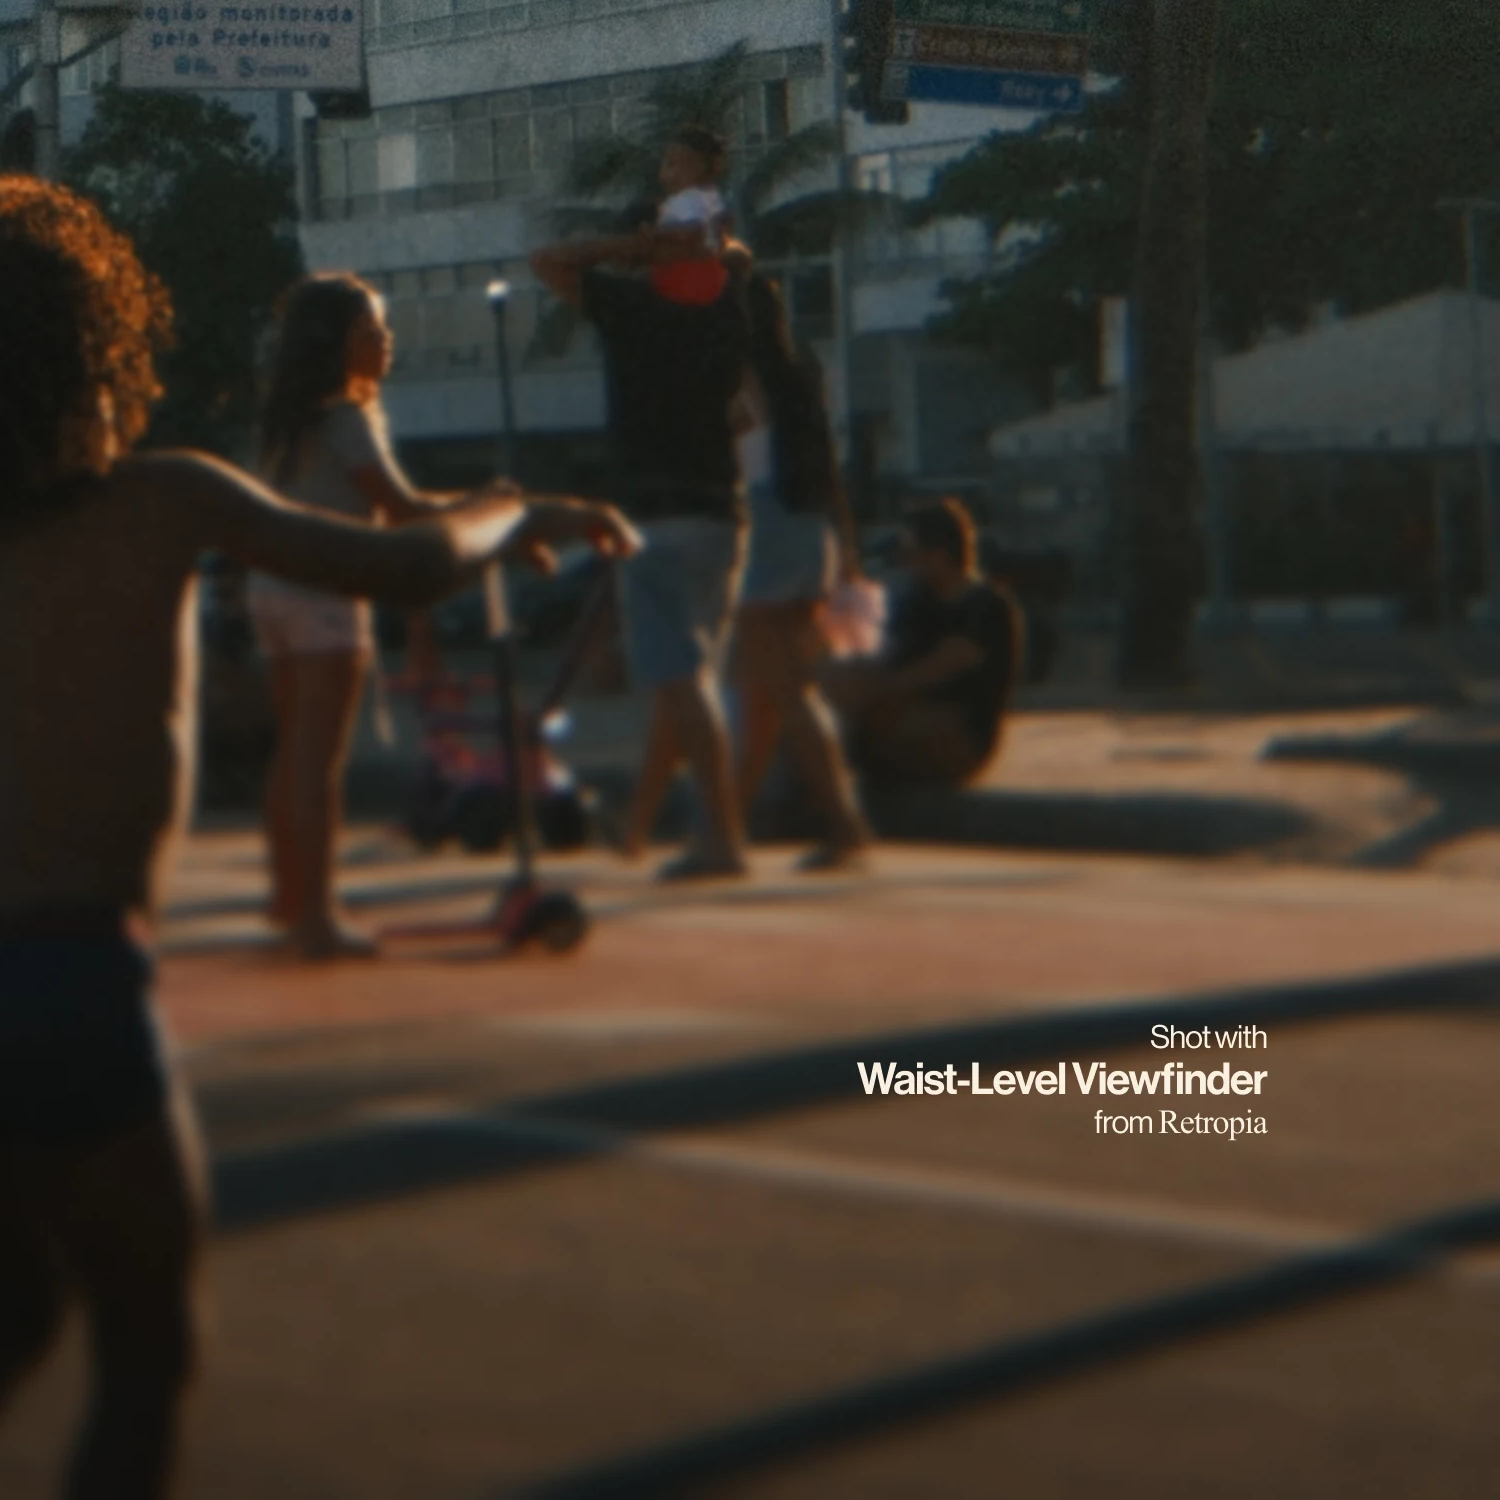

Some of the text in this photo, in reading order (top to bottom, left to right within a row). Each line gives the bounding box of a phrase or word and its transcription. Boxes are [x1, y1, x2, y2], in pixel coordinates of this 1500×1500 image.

[140, 1, 355, 26] egião monitorada
[150, 28, 332, 49] pela Prefeitura
